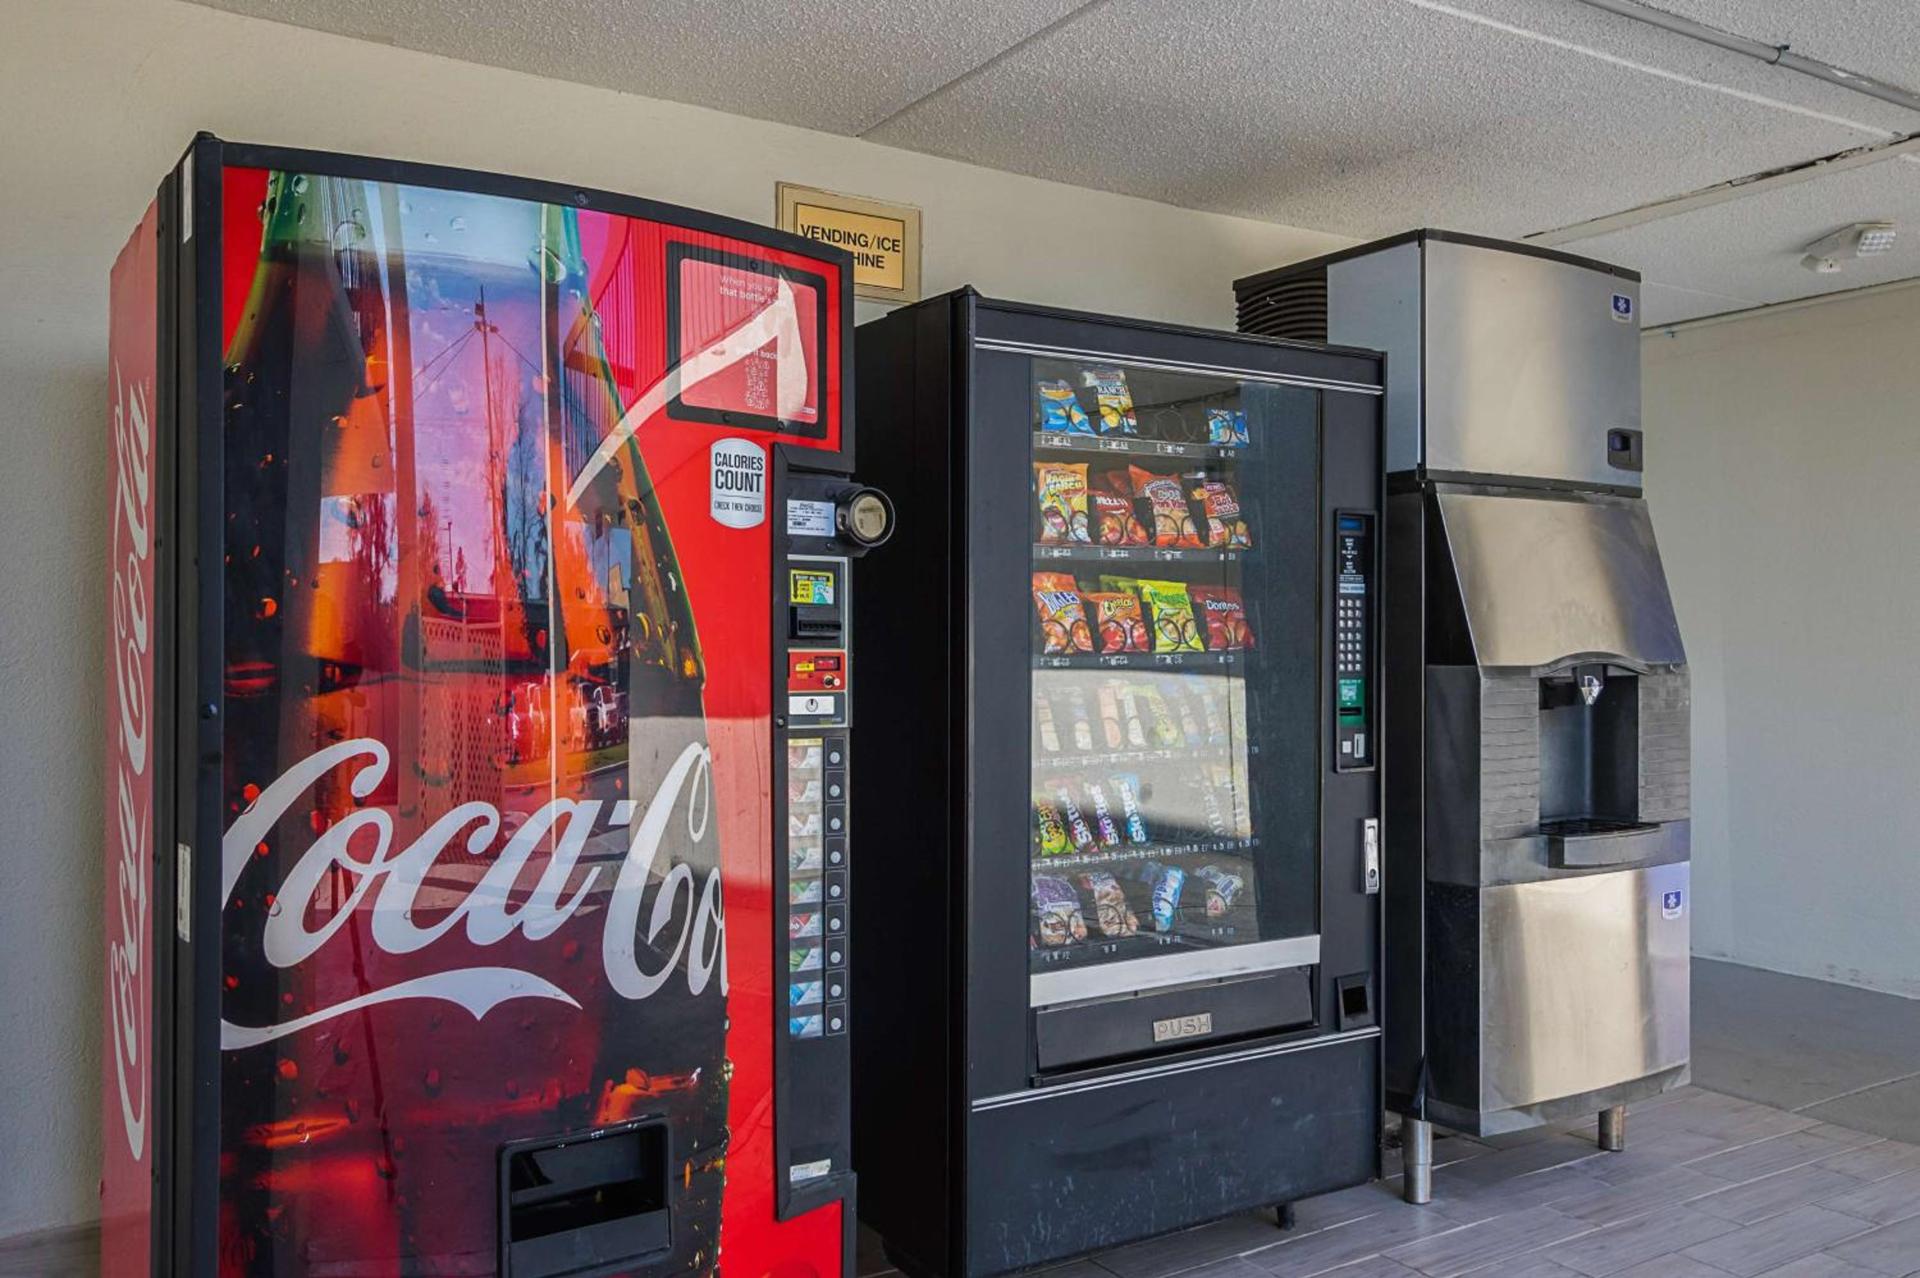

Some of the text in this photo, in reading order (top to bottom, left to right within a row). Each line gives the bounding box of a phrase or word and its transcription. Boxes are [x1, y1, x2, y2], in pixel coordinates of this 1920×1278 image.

[801, 224, 901, 253] VENDING/ICE
[854, 252, 885, 269] HINE
[714, 451, 764, 472] CALORIES
[715, 469, 763, 493] COUNT
[1157, 1015, 1210, 1040] PUSH
